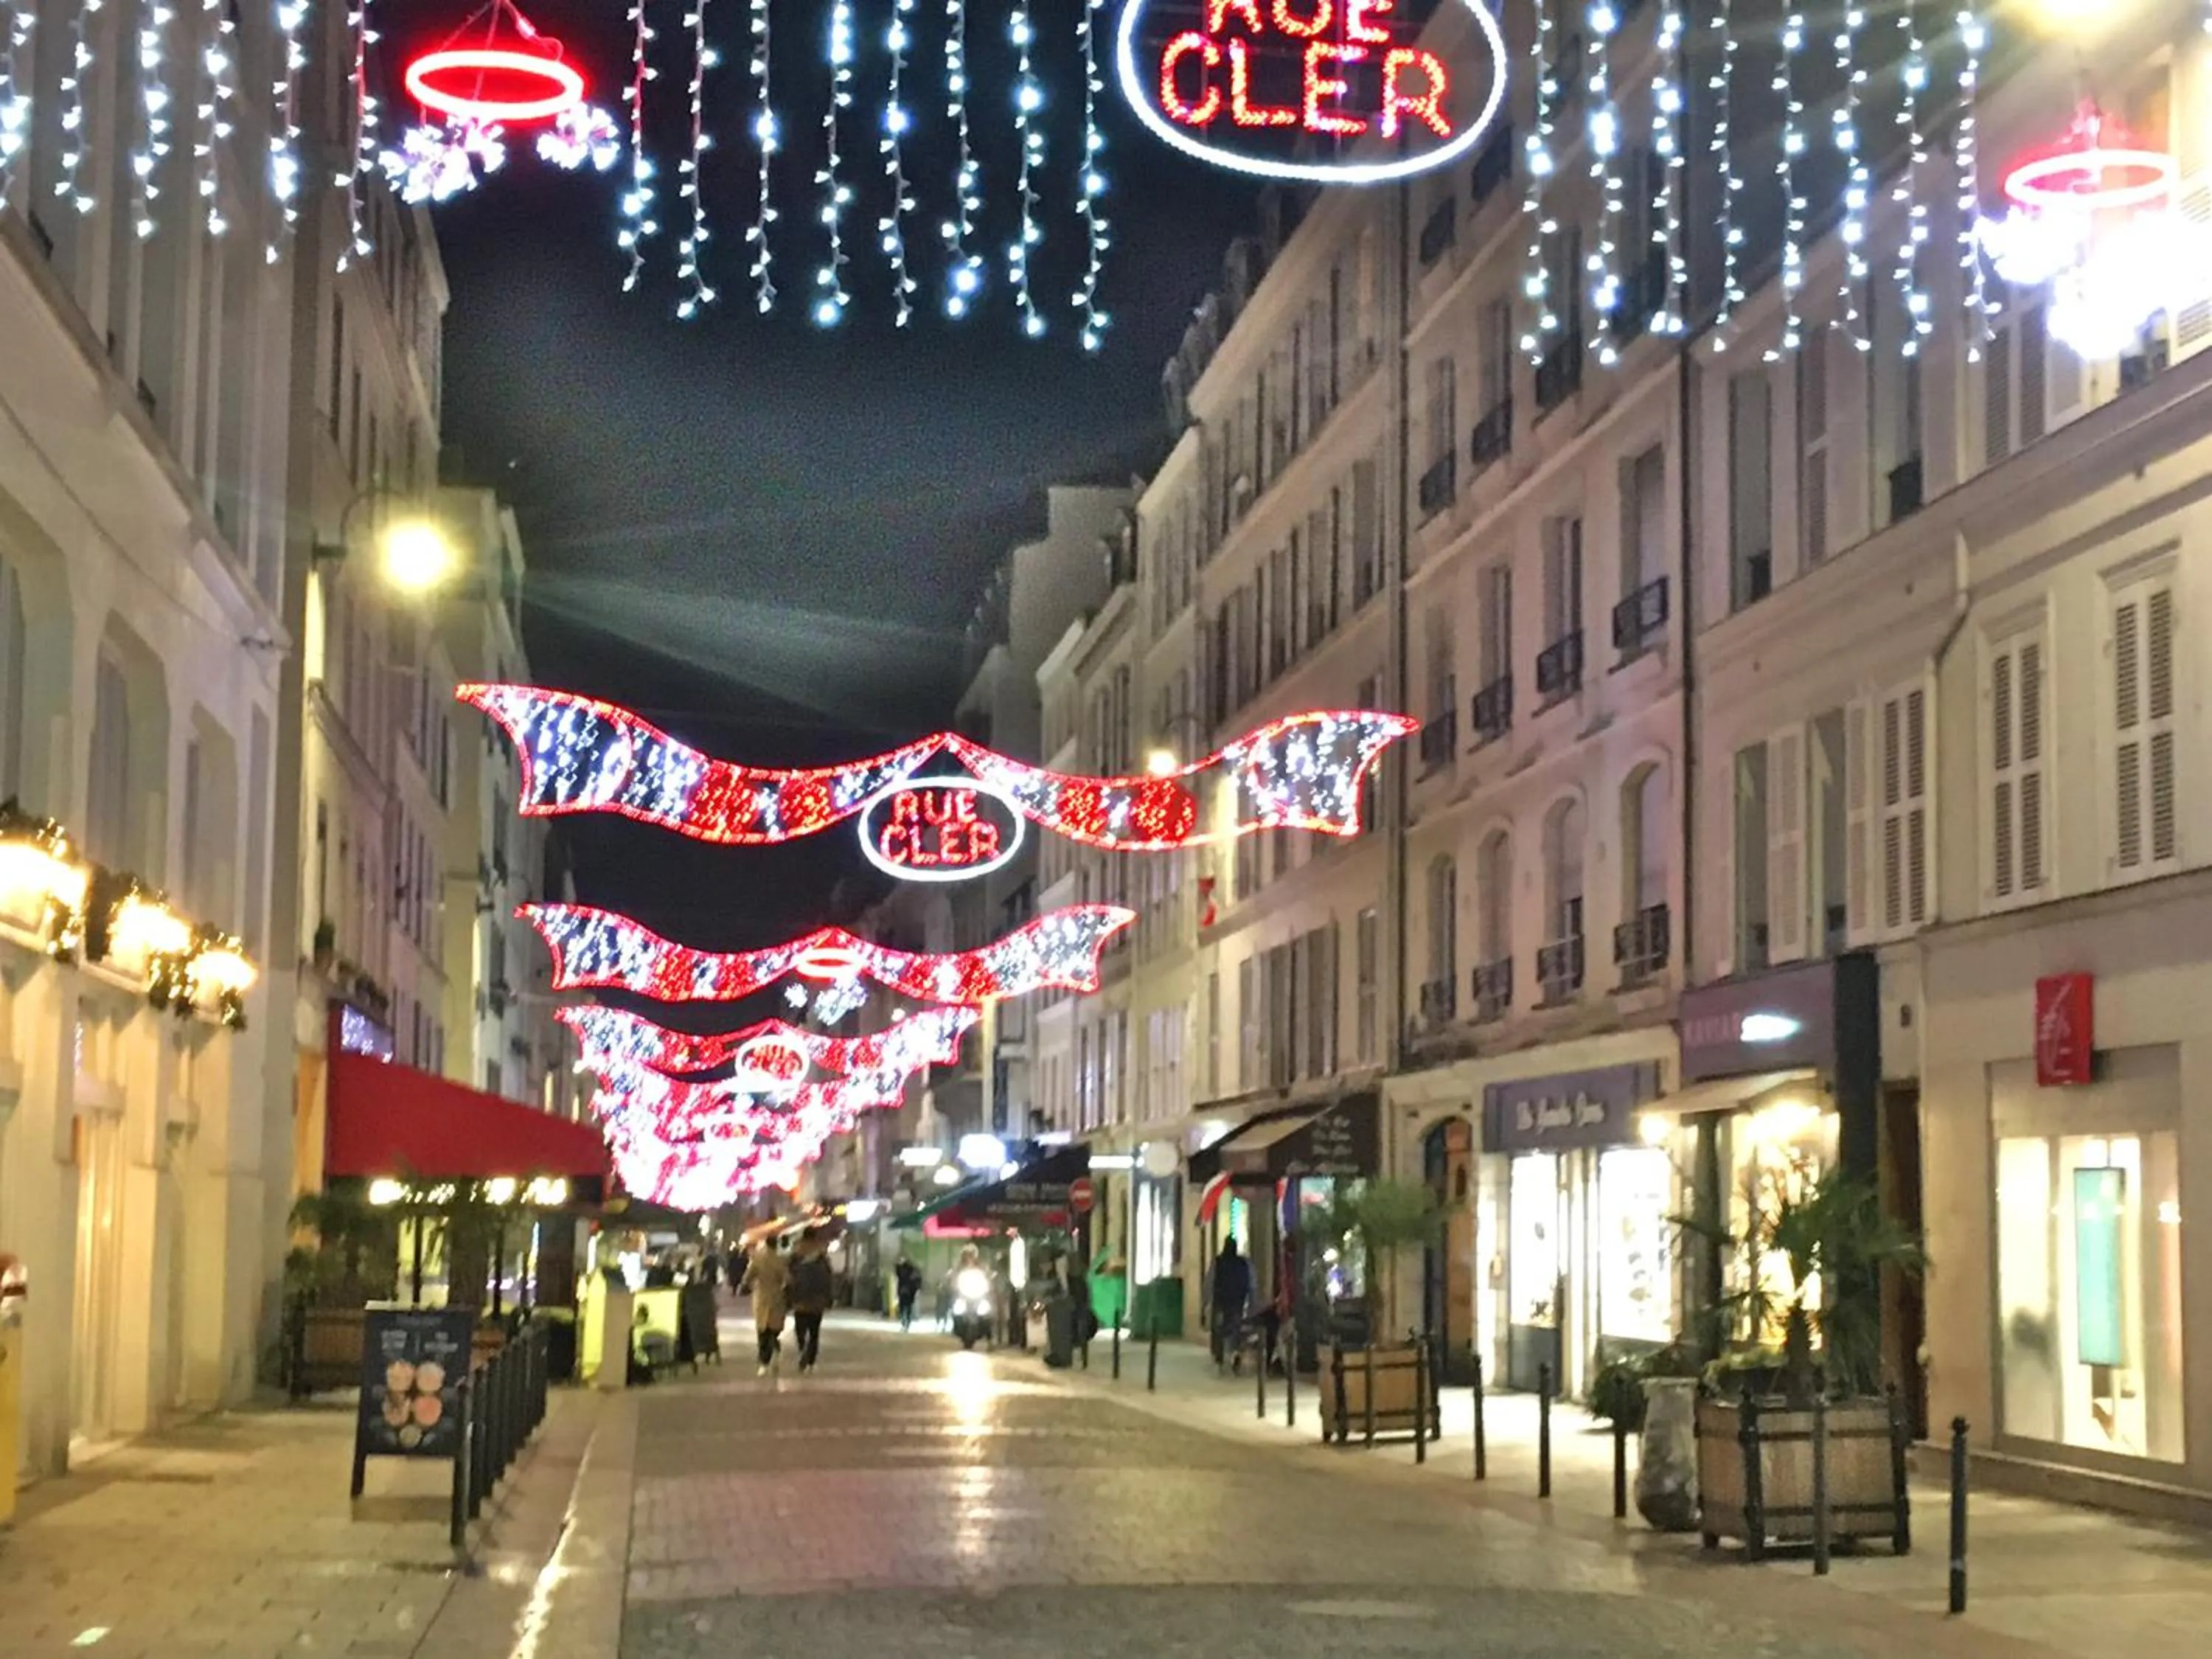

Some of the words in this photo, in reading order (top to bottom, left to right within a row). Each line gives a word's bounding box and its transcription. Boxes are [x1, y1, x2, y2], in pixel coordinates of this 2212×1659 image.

[1160, 31, 1453, 139] CLER
[893, 789, 977, 825] RUE
[880, 821, 1000, 867] CLER
